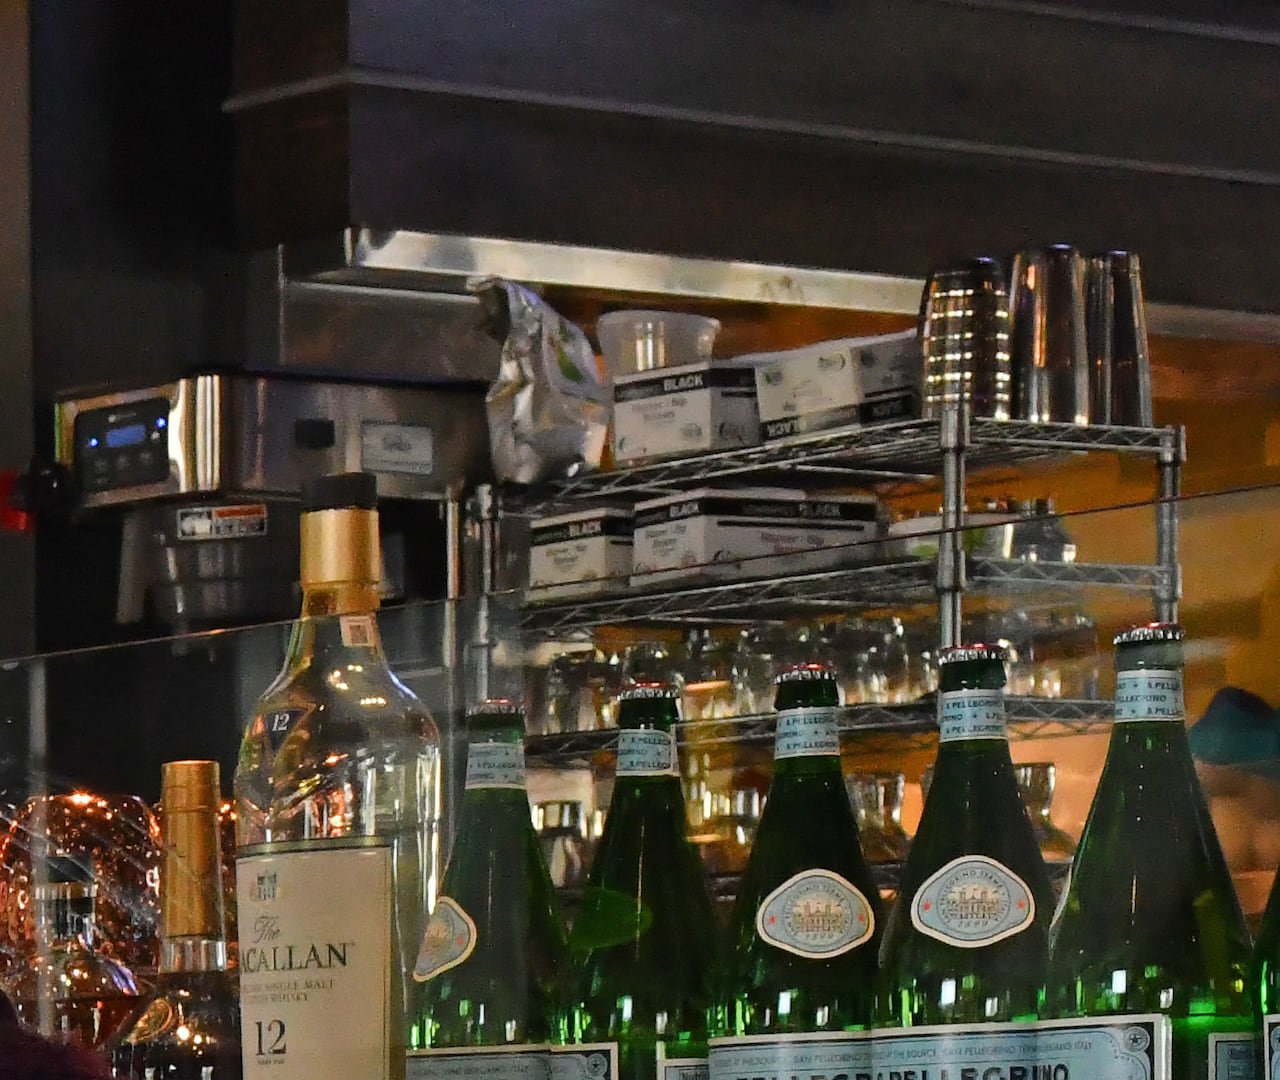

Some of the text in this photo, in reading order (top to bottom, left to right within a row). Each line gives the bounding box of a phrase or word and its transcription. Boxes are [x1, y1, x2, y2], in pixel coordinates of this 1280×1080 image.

[663, 373, 704, 391] BLACK
[272, 713, 290, 732] 12
[253, 915, 281, 944] The
[240, 944, 349, 974] ACALLAN
[255, 1019, 287, 1056] 12
